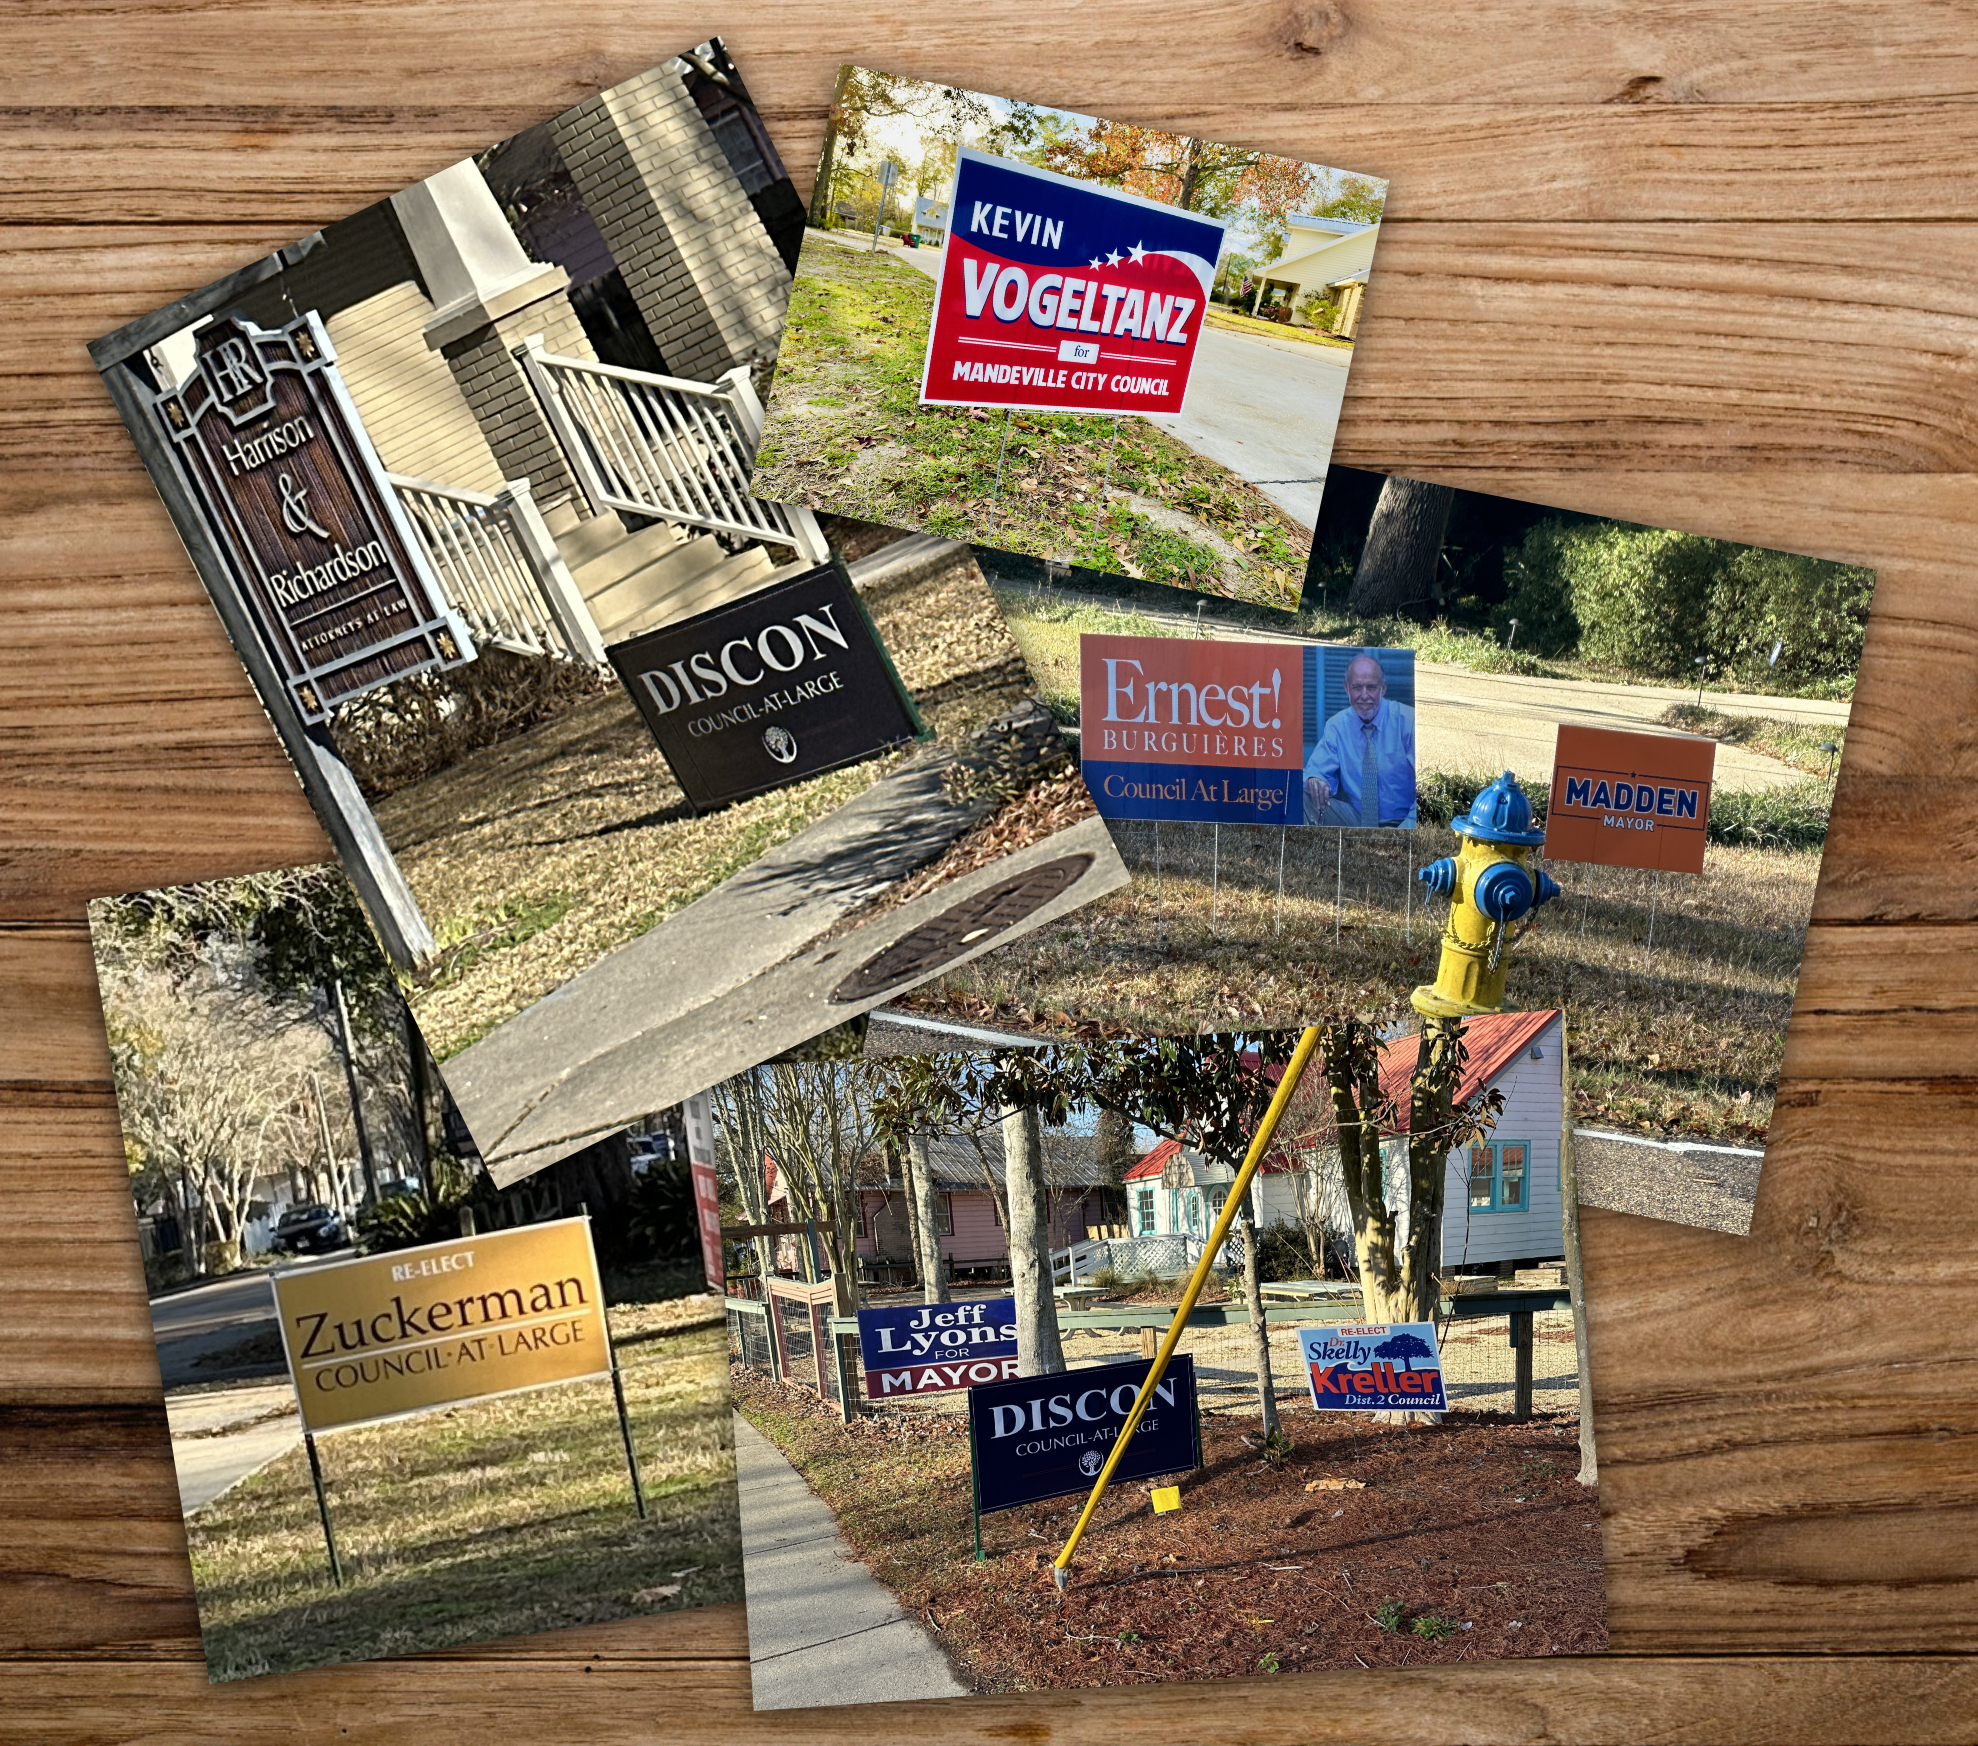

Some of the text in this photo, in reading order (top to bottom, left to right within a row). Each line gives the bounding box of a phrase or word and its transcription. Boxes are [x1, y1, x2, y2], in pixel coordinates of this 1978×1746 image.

[970, 201, 1064, 250] KEVIN
[963, 258, 1196, 346] VOGELTANZ
[1073, 345, 1090, 359] for
[952, 361, 1170, 396] MANDEVILLE CITY COUNCIL
[222, 415, 314, 476] Harrison
[279, 473, 330, 539] &
[270, 540, 388, 608] Richardson
[300, 598, 408, 652] ATTORNEYS AT LAW
[638, 603, 849, 715] DISCON
[688, 671, 844, 737] COUNCIL-AT-LARGE
[1101, 658, 1282, 730] Ernest!
[1103, 729, 1283, 758] BURGUIÈRES
[1103, 774, 1284, 811] Council At Large
[1565, 776, 1699, 819] MADDEN
[1602, 814, 1655, 832] MAYOR
[391, 1251, 476, 1282] RE-ELECT
[296, 1275, 588, 1359] Zuckerman
[910, 1303, 987, 1330] Jeff
[1341, 1326, 1387, 1336] RE-ELECT
[875, 1322, 1017, 1356] Lyons
[934, 1347, 970, 1360] FOR
[1308, 1340, 1371, 1366] Skelly
[1329, 1337, 1345, 1347] Dr.
[881, 1360, 1019, 1394] MAYOR
[1309, 1362, 1438, 1394] Kreller
[1345, 1393, 1441, 1406] Dist. 2 Council
[1016, 1419, 1159, 1457] COUNCIL-AT-LGE
